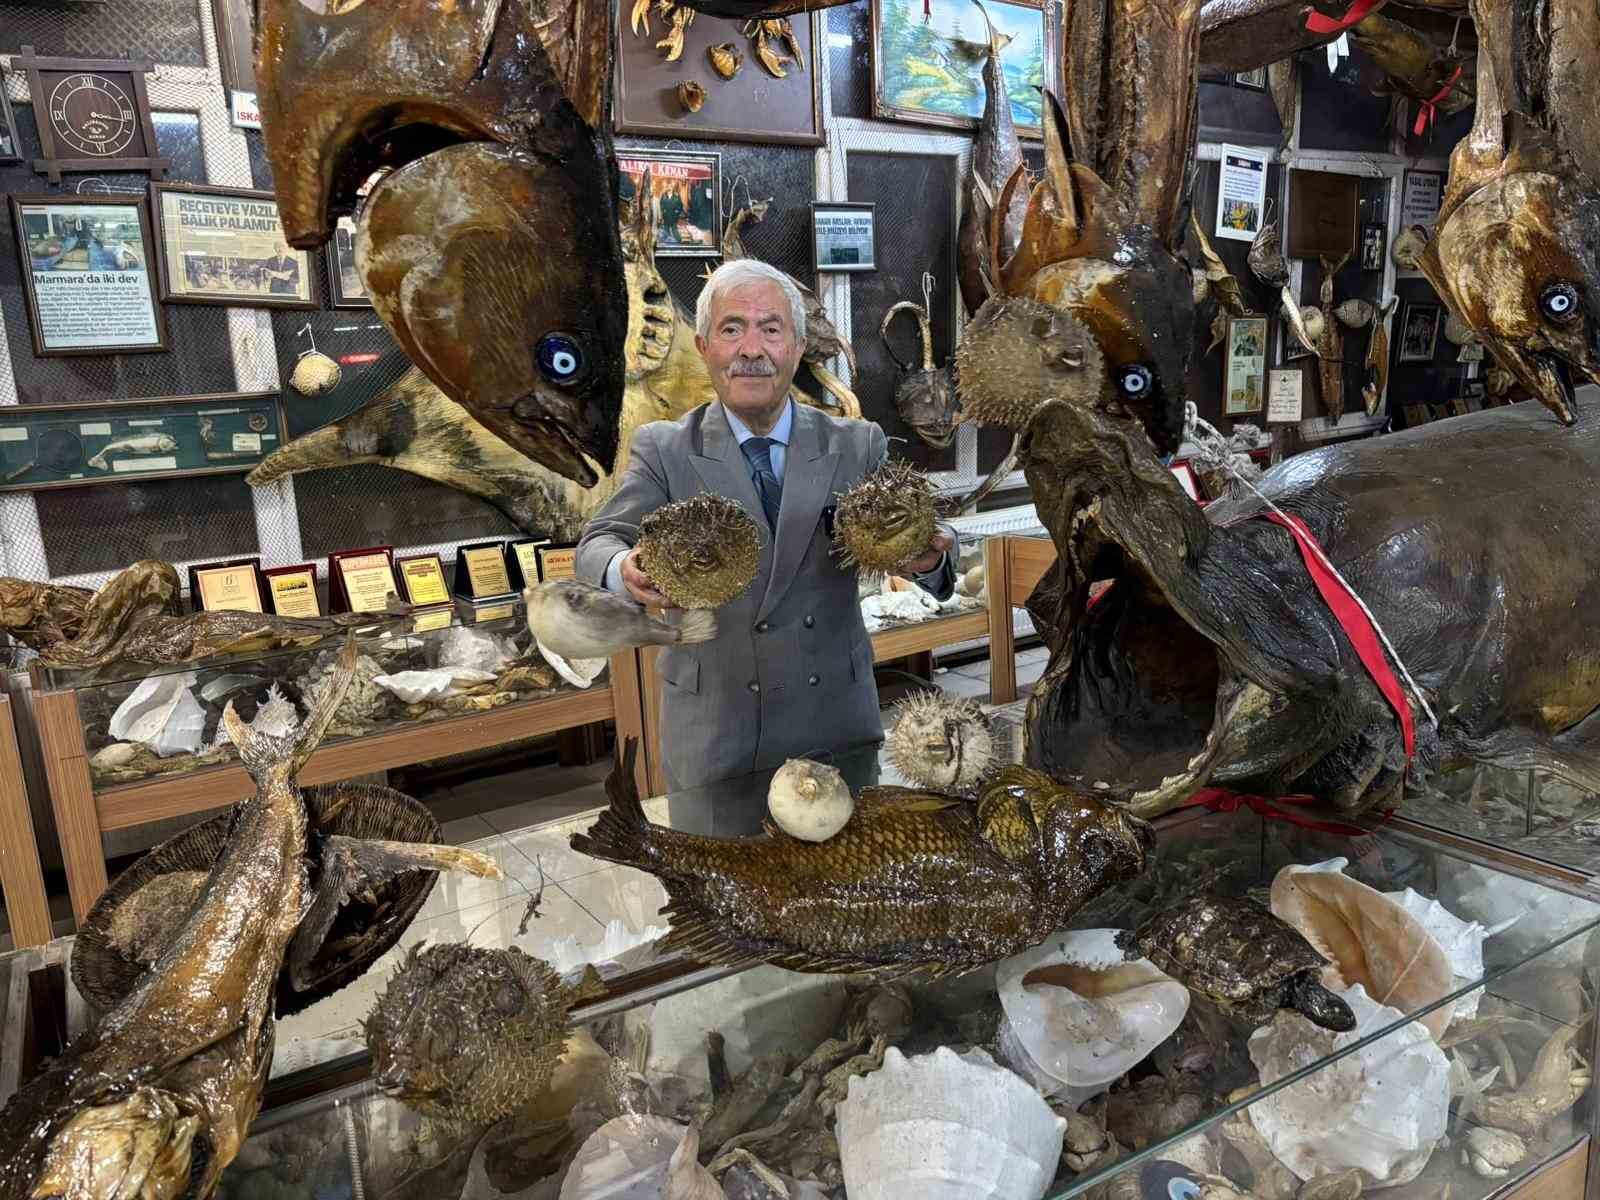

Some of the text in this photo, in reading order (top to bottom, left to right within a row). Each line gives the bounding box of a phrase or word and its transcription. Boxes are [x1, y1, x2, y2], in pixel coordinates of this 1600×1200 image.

[34, 273, 139, 284] Marmara'da iki dev
